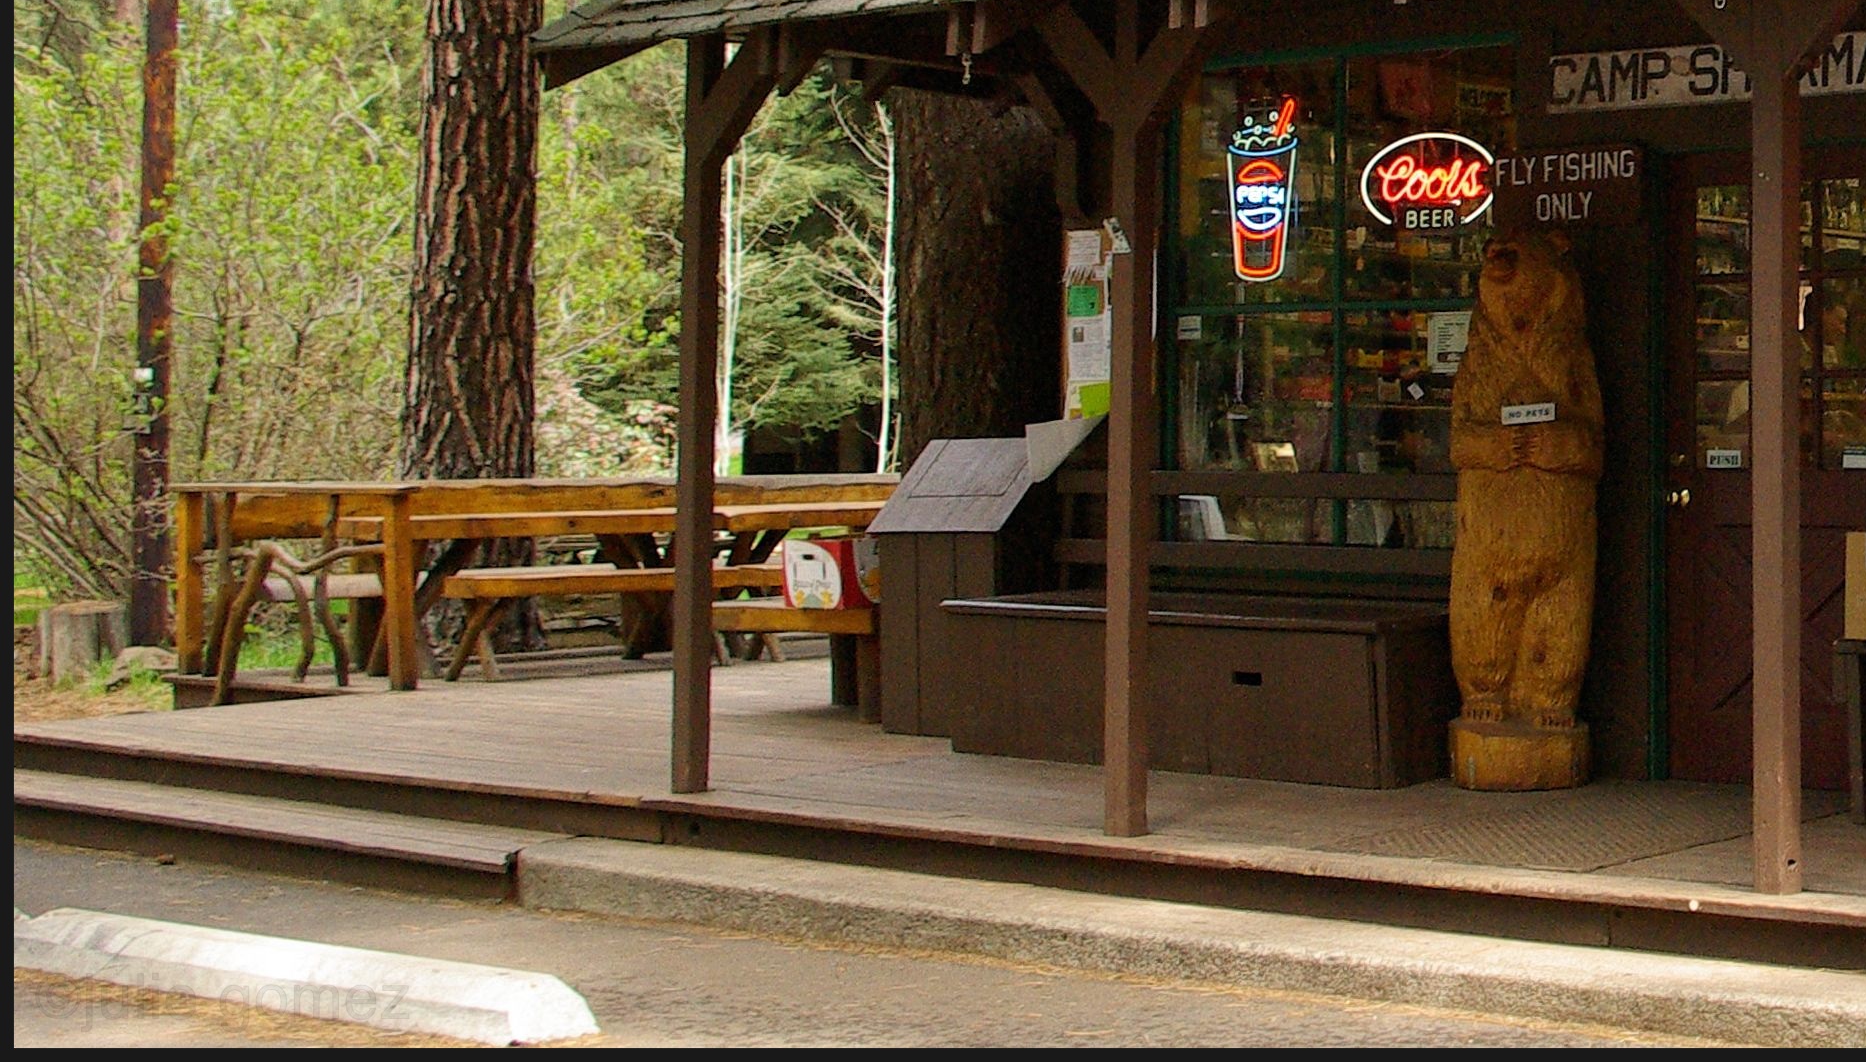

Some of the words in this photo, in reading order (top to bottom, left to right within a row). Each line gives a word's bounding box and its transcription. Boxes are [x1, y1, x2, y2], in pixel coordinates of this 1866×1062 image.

[1549, 49, 1672, 107] CAMP
[1376, 154, 1488, 203] Coors
[1495, 156, 1539, 187] FLY
[1543, 149, 1636, 184] FISHING
[1236, 184, 1285, 205] PEPSI
[1535, 191, 1593, 222] ONLY
[1405, 209, 1455, 228] BEER
[1709, 454, 1740, 466] PUSH
